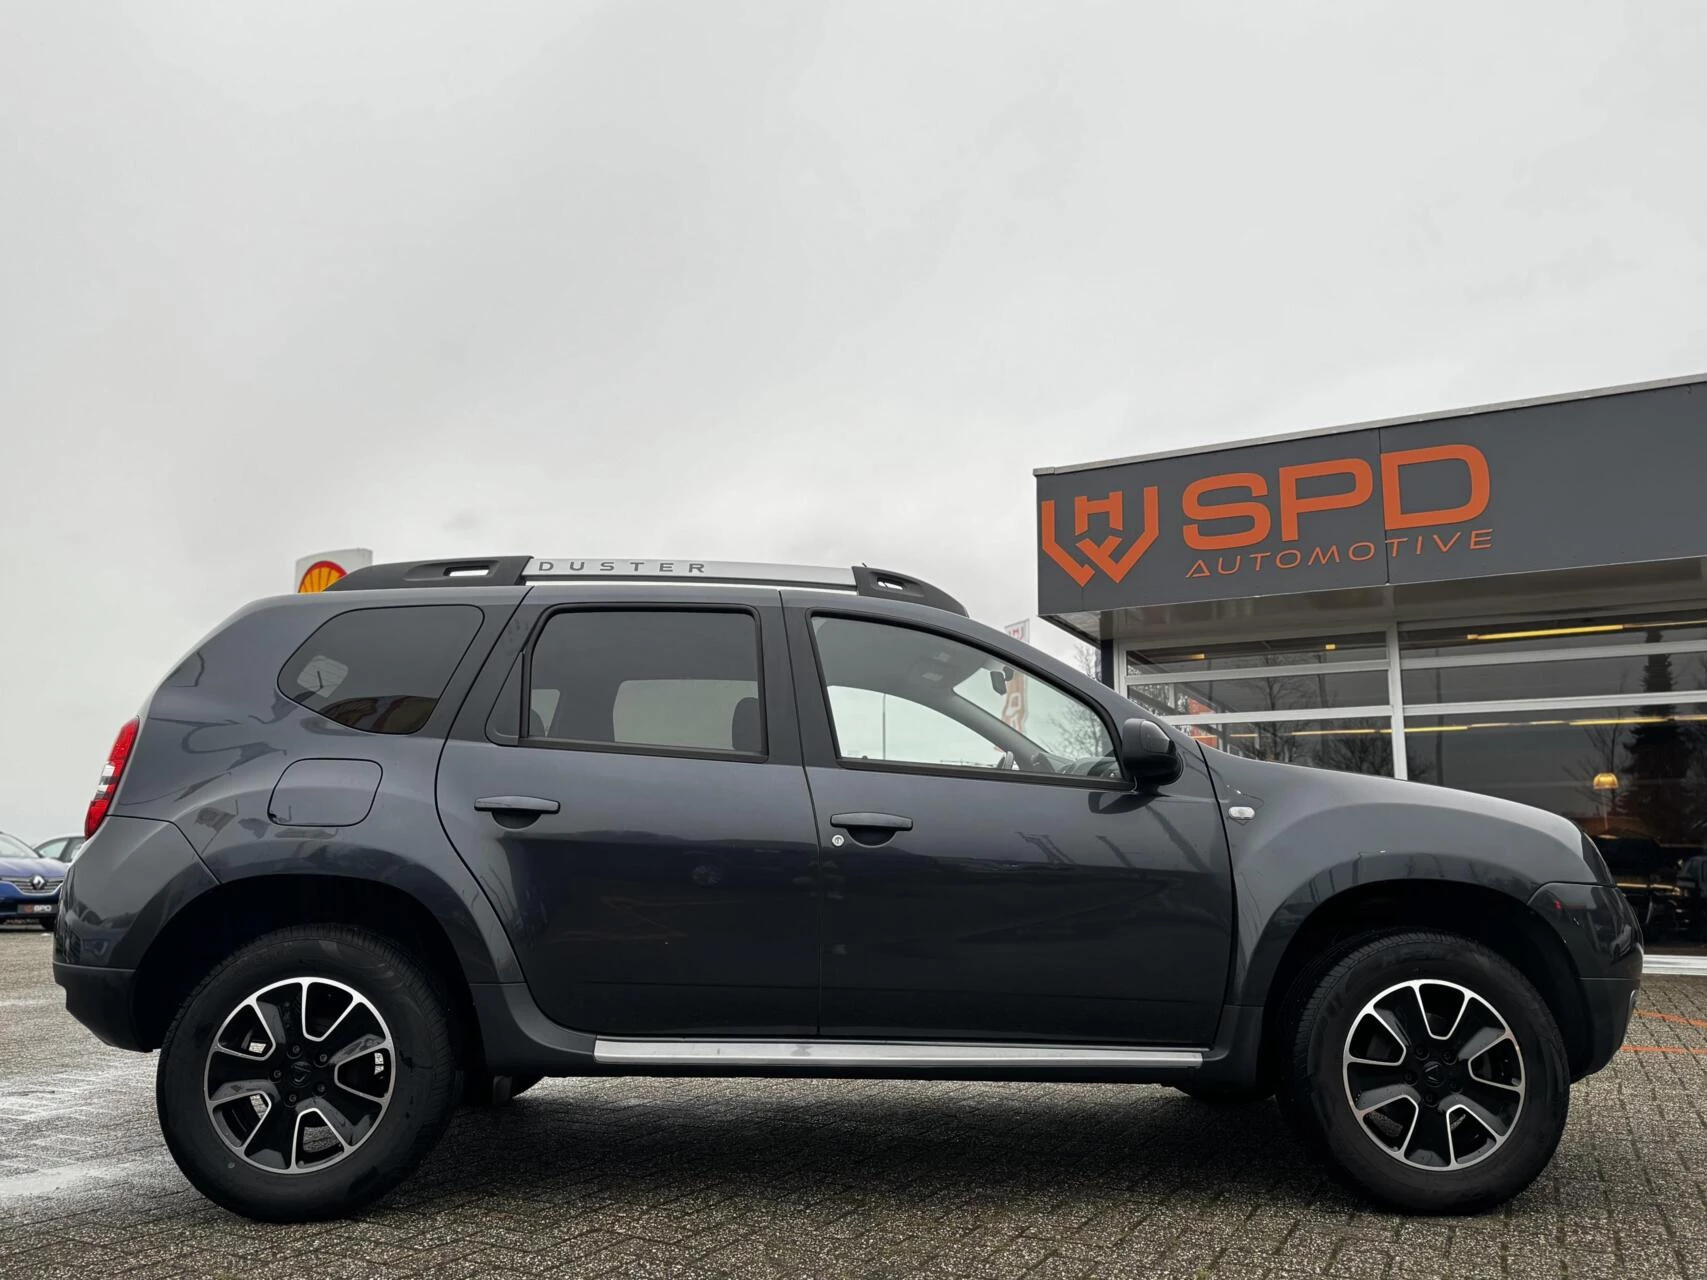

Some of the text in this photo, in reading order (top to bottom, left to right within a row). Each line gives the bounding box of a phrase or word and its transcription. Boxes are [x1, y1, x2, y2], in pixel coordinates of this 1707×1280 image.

[1182, 444, 1491, 551] SPD
[538, 561, 705, 573] DUSTER
[1185, 528, 1495, 579] AUTOMOTIVE
